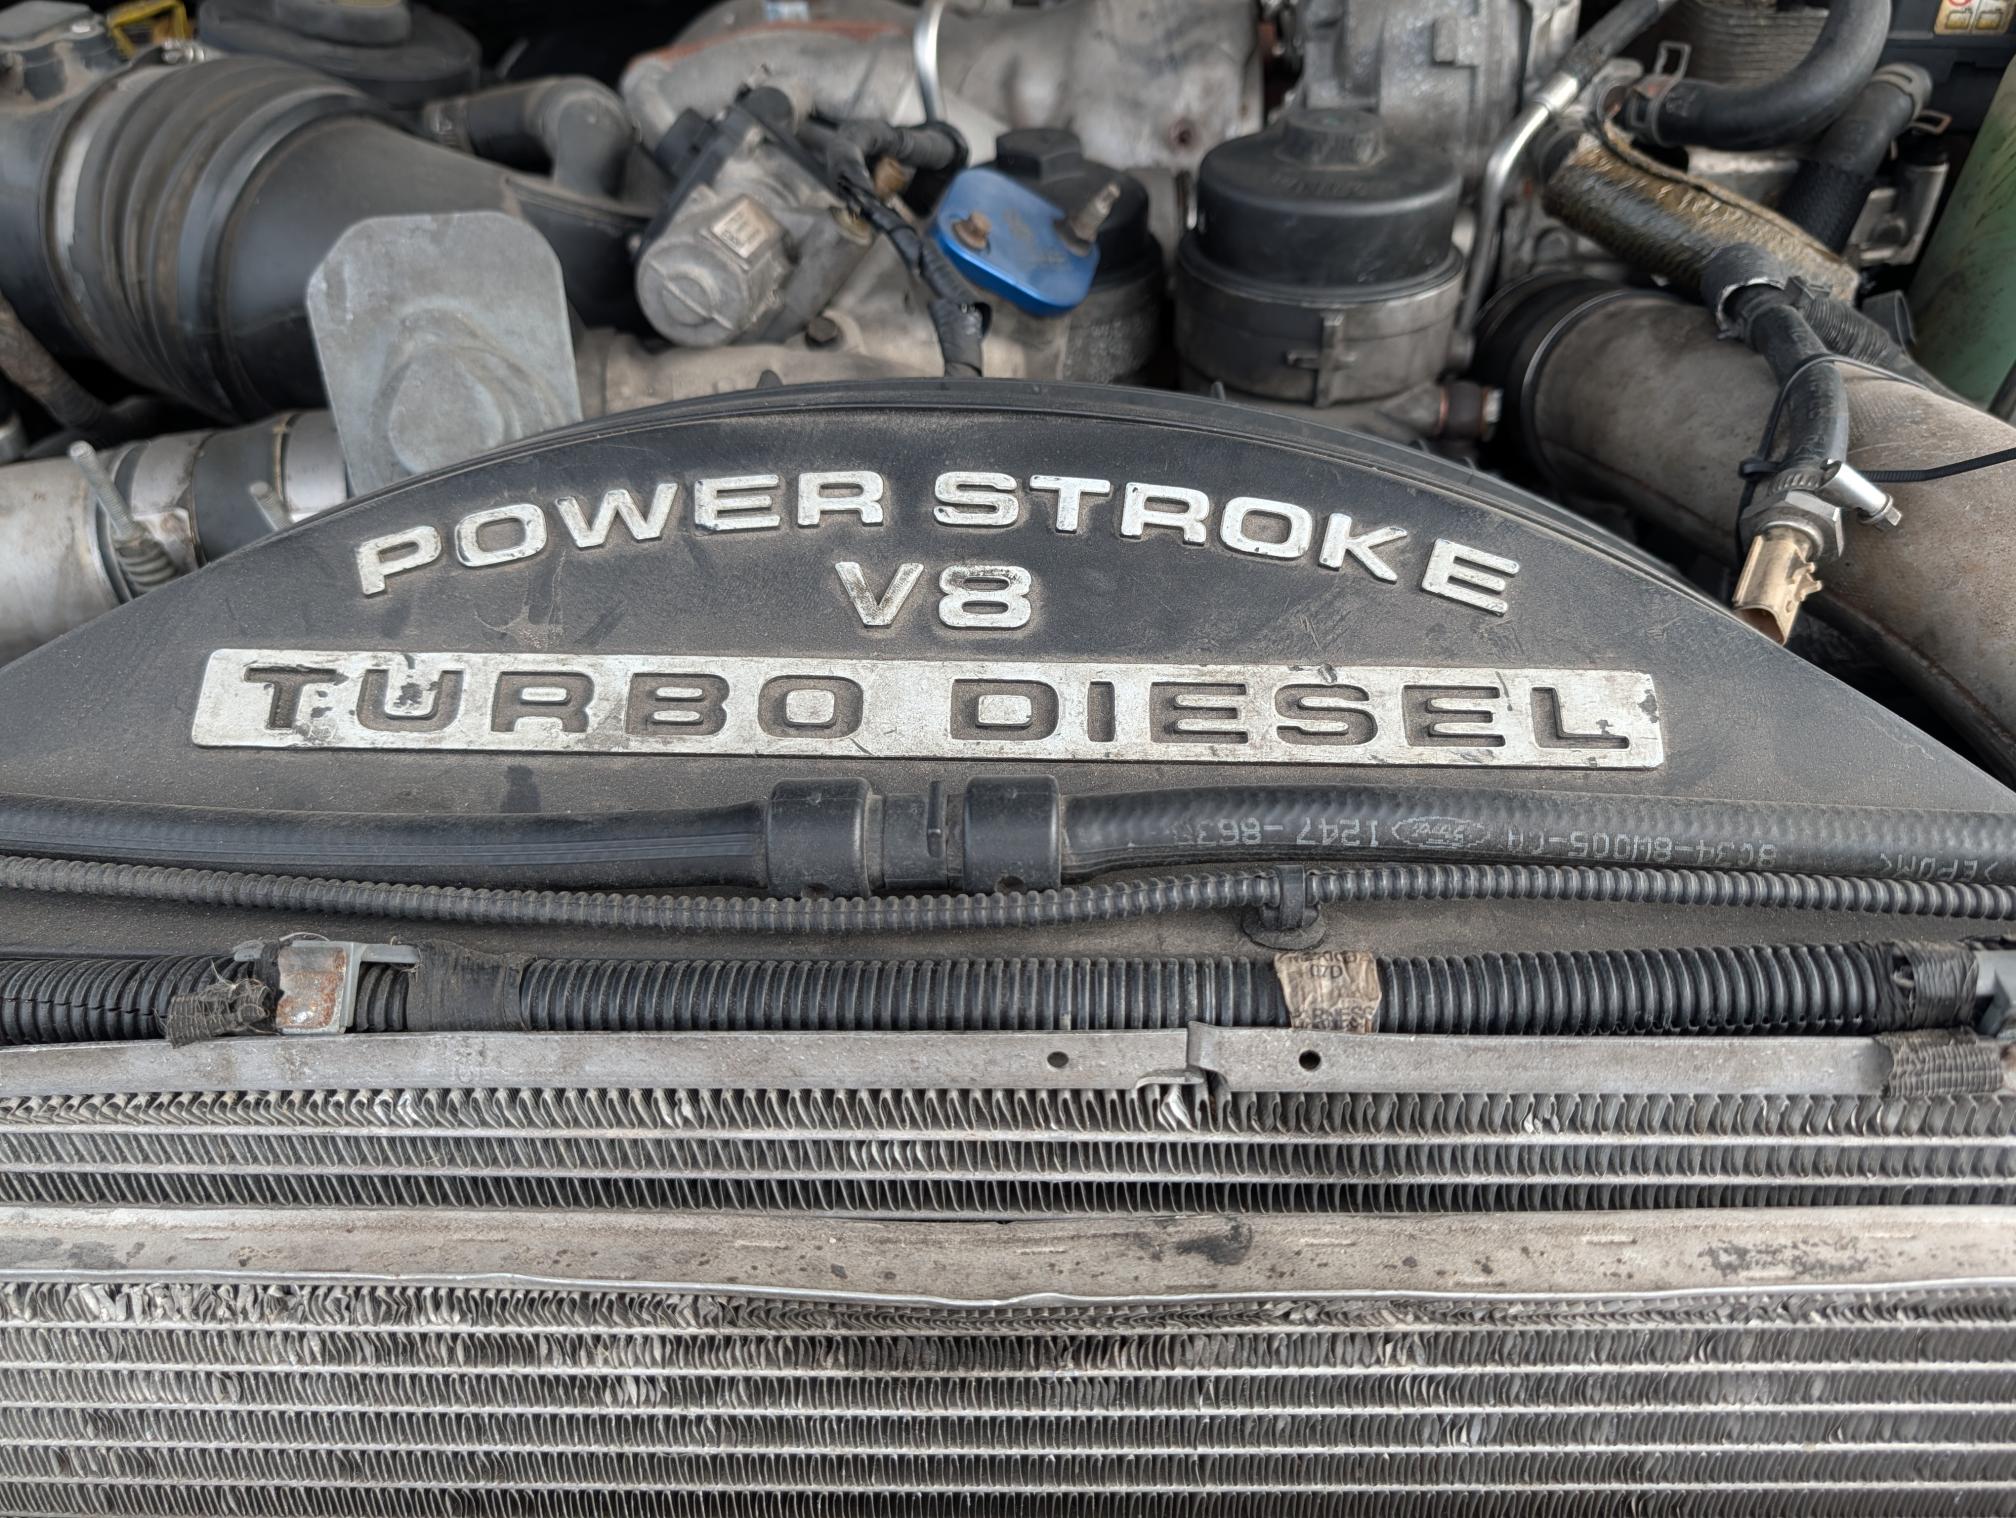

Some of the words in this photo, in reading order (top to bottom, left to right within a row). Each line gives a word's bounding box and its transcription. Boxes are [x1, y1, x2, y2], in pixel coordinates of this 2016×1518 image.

[356, 470, 885, 595] POWER
[934, 471, 1520, 616] STROKE
[834, 561, 1033, 628] V8
[243, 665, 866, 740] TURBO
[950, 678, 1631, 750] DIESEL
[1296, 816, 1378, 847] 1247
